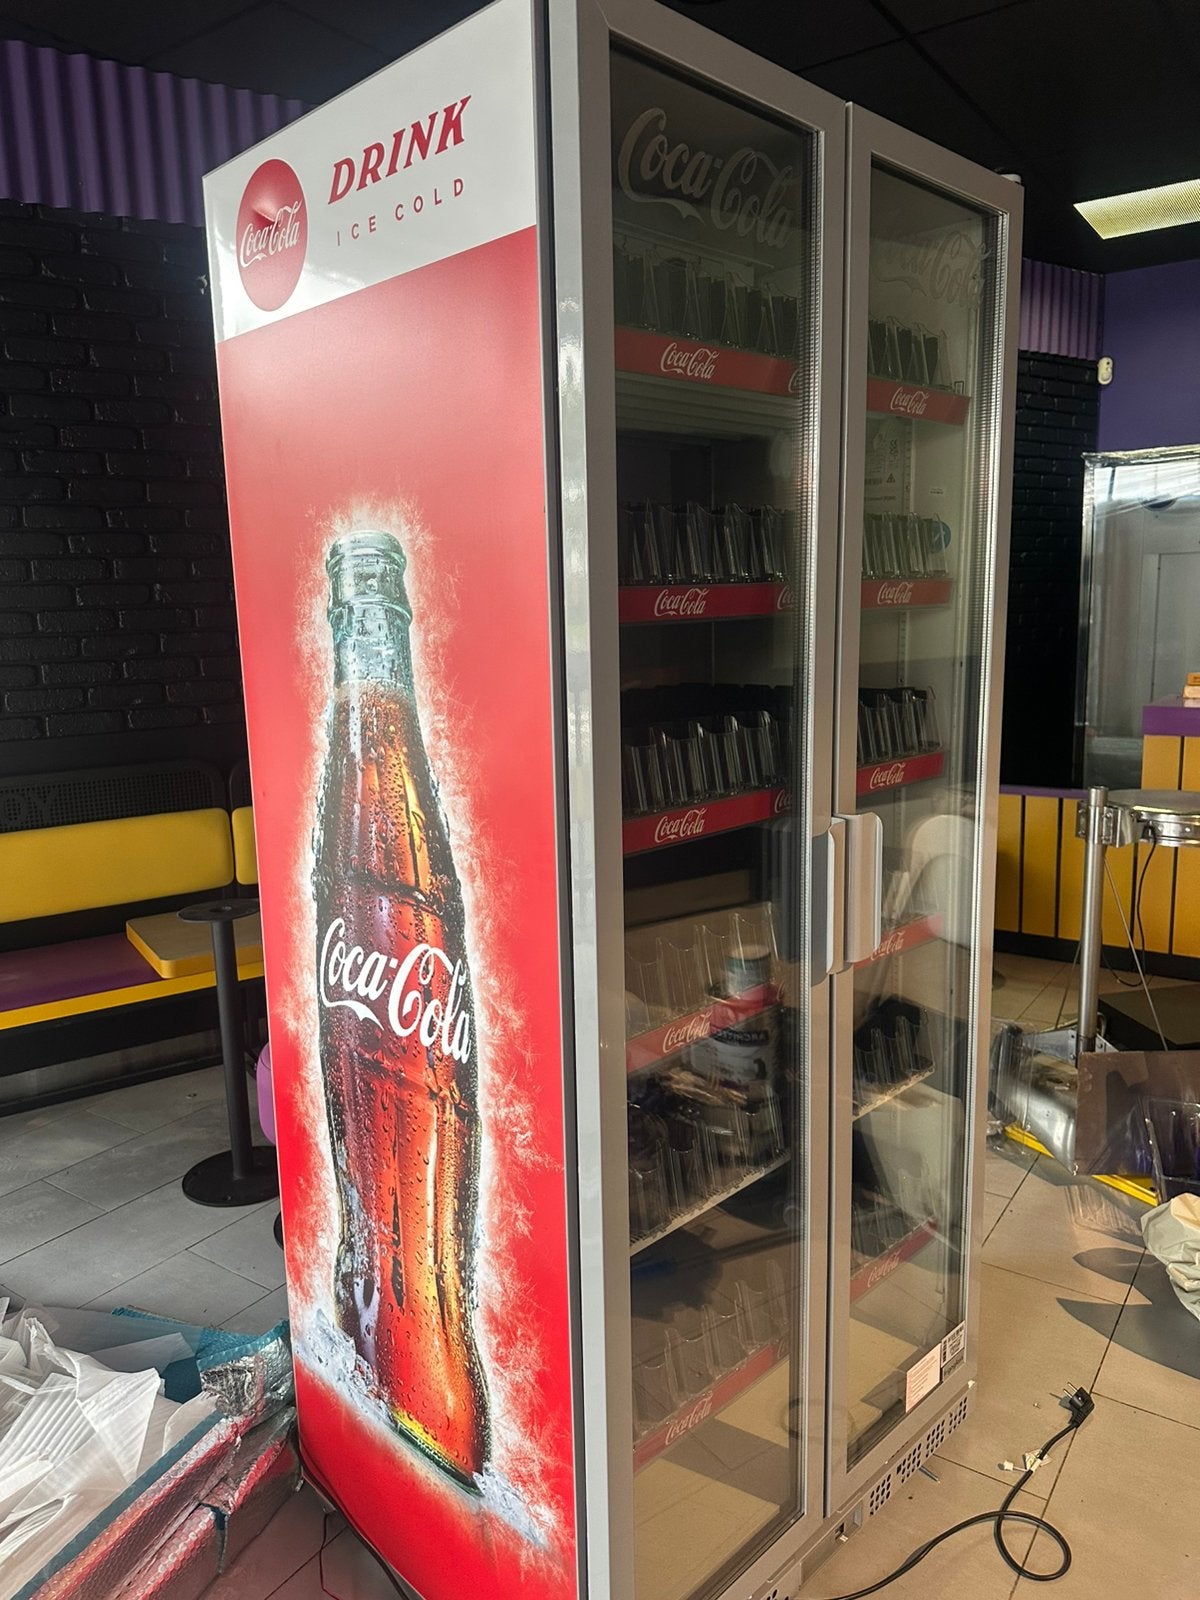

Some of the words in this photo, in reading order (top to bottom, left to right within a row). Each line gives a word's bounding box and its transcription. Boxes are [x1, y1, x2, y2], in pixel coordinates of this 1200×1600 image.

[328, 95, 472, 205] DRINK
[618, 107, 798, 248] Coca-Cola
[240, 199, 303, 267] Coca-Cola
[337, 215, 377, 247] ICE
[395, 178, 465, 222] COLD
[660, 342, 720, 379] Coca-Cola
[890, 386, 929, 415] Coca-Cola
[654, 588, 708, 617] Coca-Cola
[877, 582, 915, 604] Coca-Cola
[870, 763, 907, 789] Coca-Cola
[655, 808, 708, 842] Coca-Cola
[320, 918, 471, 1064] Coca-Cola
[662, 1010, 713, 1053] Coca-Cola
[665, 1394, 713, 1446] Coca-Cola
